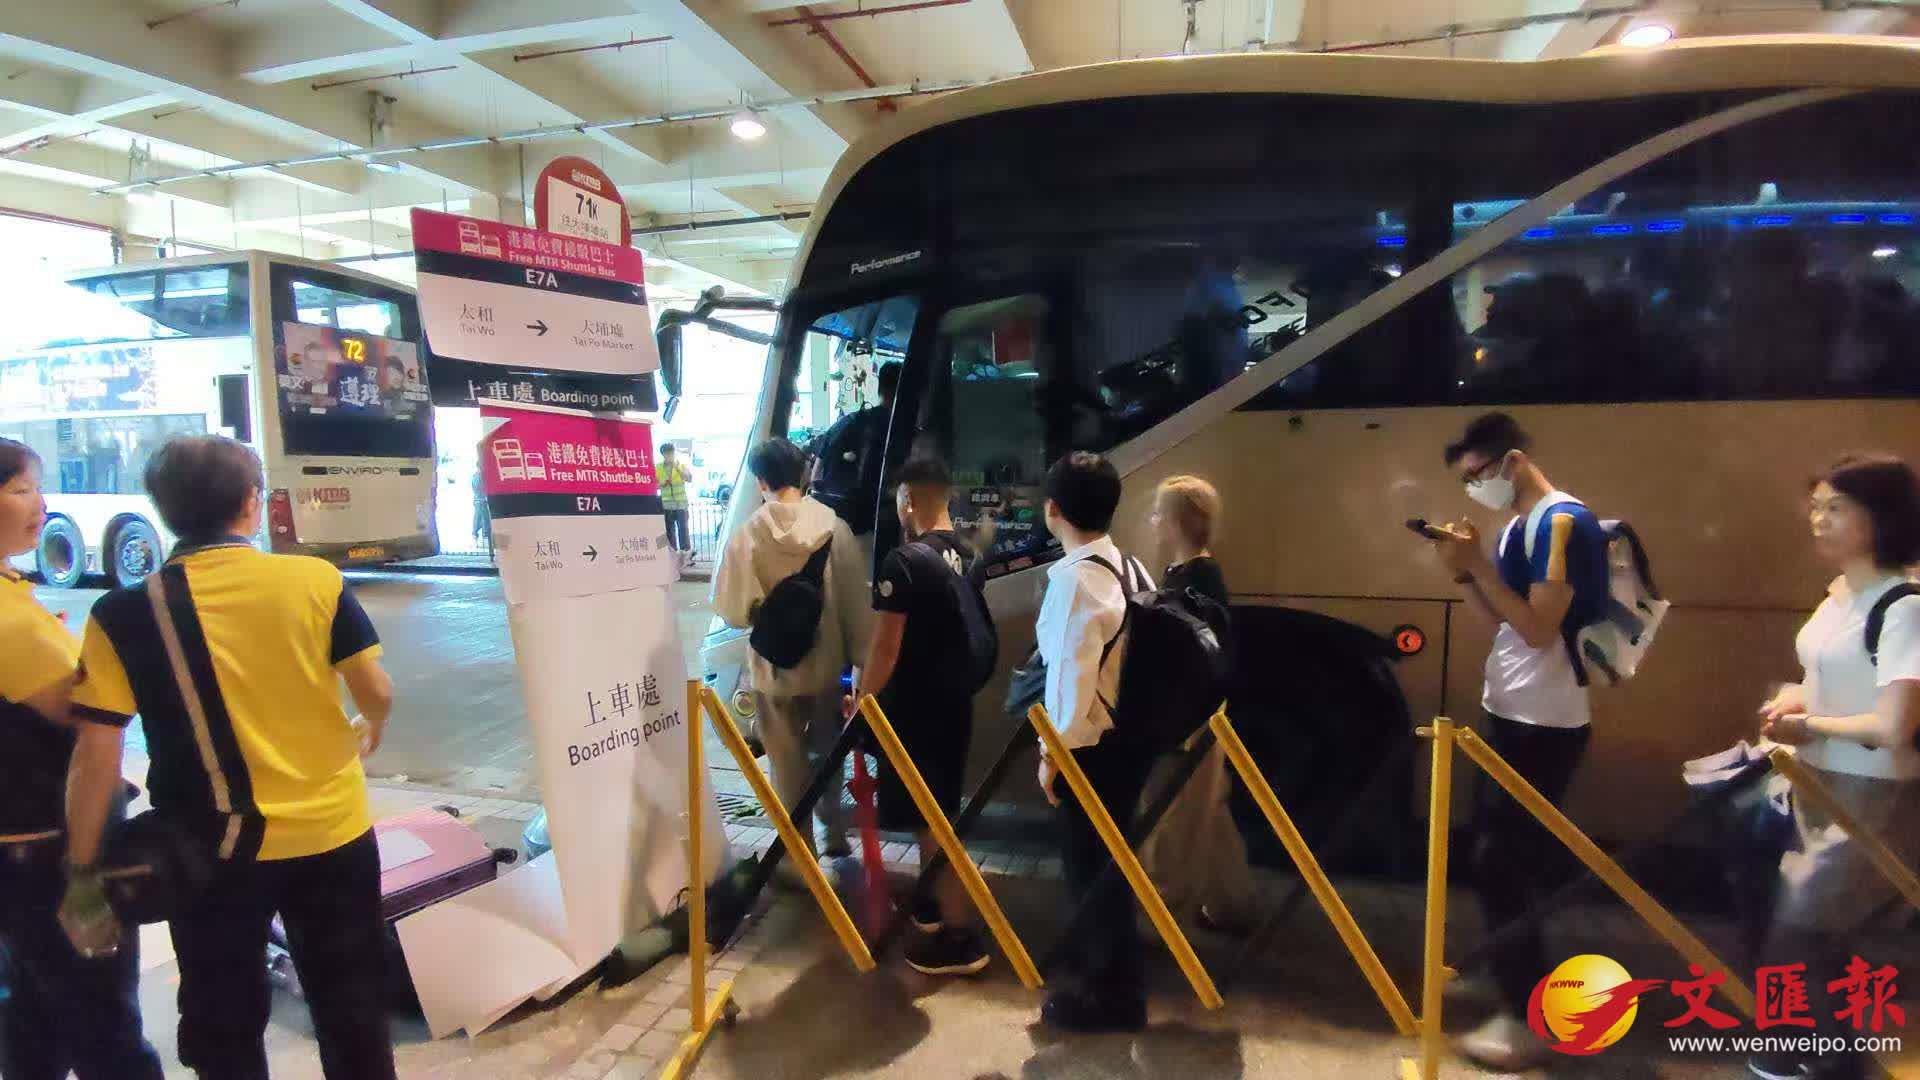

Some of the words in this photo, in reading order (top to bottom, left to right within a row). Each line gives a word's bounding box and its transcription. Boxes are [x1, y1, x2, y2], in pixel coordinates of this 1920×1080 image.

[509, 250, 533, 264] Free
[535, 253, 559, 268] MTR
[560, 258, 597, 275] Shuttle
[597, 266, 616, 278] Bus
[851, 250, 922, 274] Performance
[525, 268, 559, 289] E7A
[459, 303, 494, 322] 太和
[460, 324, 475, 335] Tai
[476, 326, 495, 337] Wo
[582, 319, 624, 337] 大埔墟
[342, 338, 366, 363] 72
[573, 336, 586, 347] Tai
[587, 338, 600, 348] Po
[602, 339, 634, 350] Market
[464, 379, 535, 401] 上車處
[541, 388, 599, 406] Boarding
[601, 391, 635, 406] point
[547, 441, 649, 468] 港鐵免費接駁巴士
[550, 467, 574, 482] Free
[576, 469, 599, 482] MTR
[600, 470, 634, 484] Shuttle
[634, 472, 652, 484] Bus
[576, 495, 601, 511] E7A
[534, 540, 561, 557] 太和
[535, 561, 549, 571] Tai
[550, 560, 564, 570] Wo
[584, 674, 662, 728] 上車處
[568, 726, 640, 766] Boarding
[642, 710, 681, 742] point
